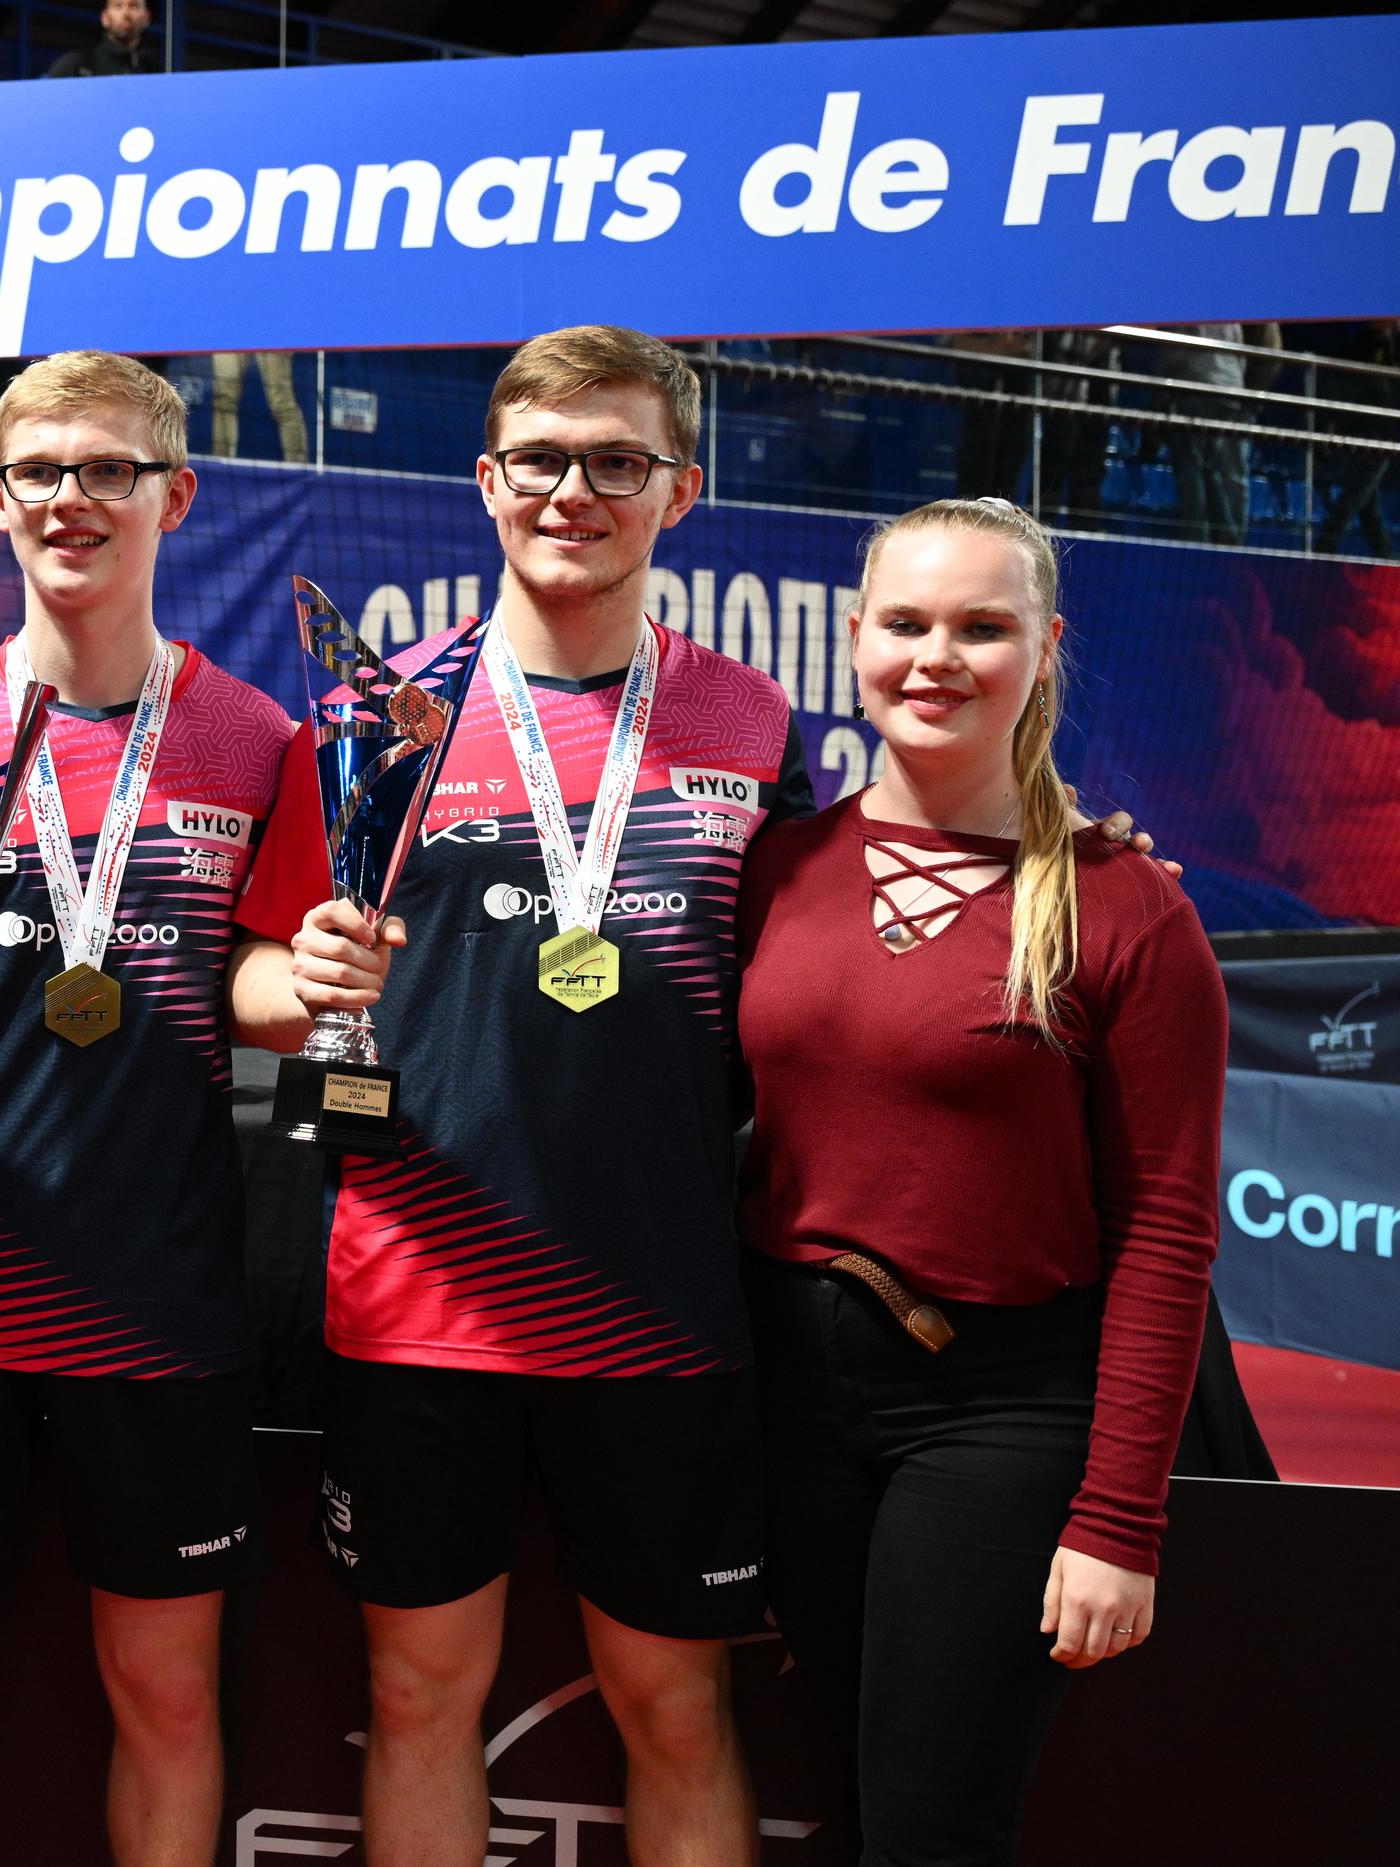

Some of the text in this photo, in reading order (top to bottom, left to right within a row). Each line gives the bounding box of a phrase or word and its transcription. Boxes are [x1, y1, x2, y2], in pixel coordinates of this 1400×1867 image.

[739, 92, 948, 236] de
[1003, 94, 1395, 225] Fran
[500, 692, 522, 731] 2024
[503, 660, 544, 754] CHAMPIONNAT DE FRANCE
[612, 667, 644, 762] CHAMPIONNAT DE FRANCE
[632, 696, 650, 736] 2024
[116, 701, 153, 801] CHAMPIONNAT DE FRANCE
[138, 731, 158, 774] 2024
[37, 753, 54, 787] FRANCE
[686, 774, 748, 802] HYLO
[182, 809, 241, 838] HYLO
[421, 818, 501, 848] K3
[551, 975, 607, 987] FFTT
[56, 1010, 108, 1022] FFTT
[1308, 1021, 1378, 1053] FFTT
[328, 1078, 358, 1089] CHAMPION
[367, 1083, 388, 1092] FRANCE
[347, 1091, 366, 1099] 2024
[330, 1099, 382, 1112] Double Hommes
[178, 1536, 231, 1558] TIBHAR
[702, 1564, 758, 1586] TIBHAR
